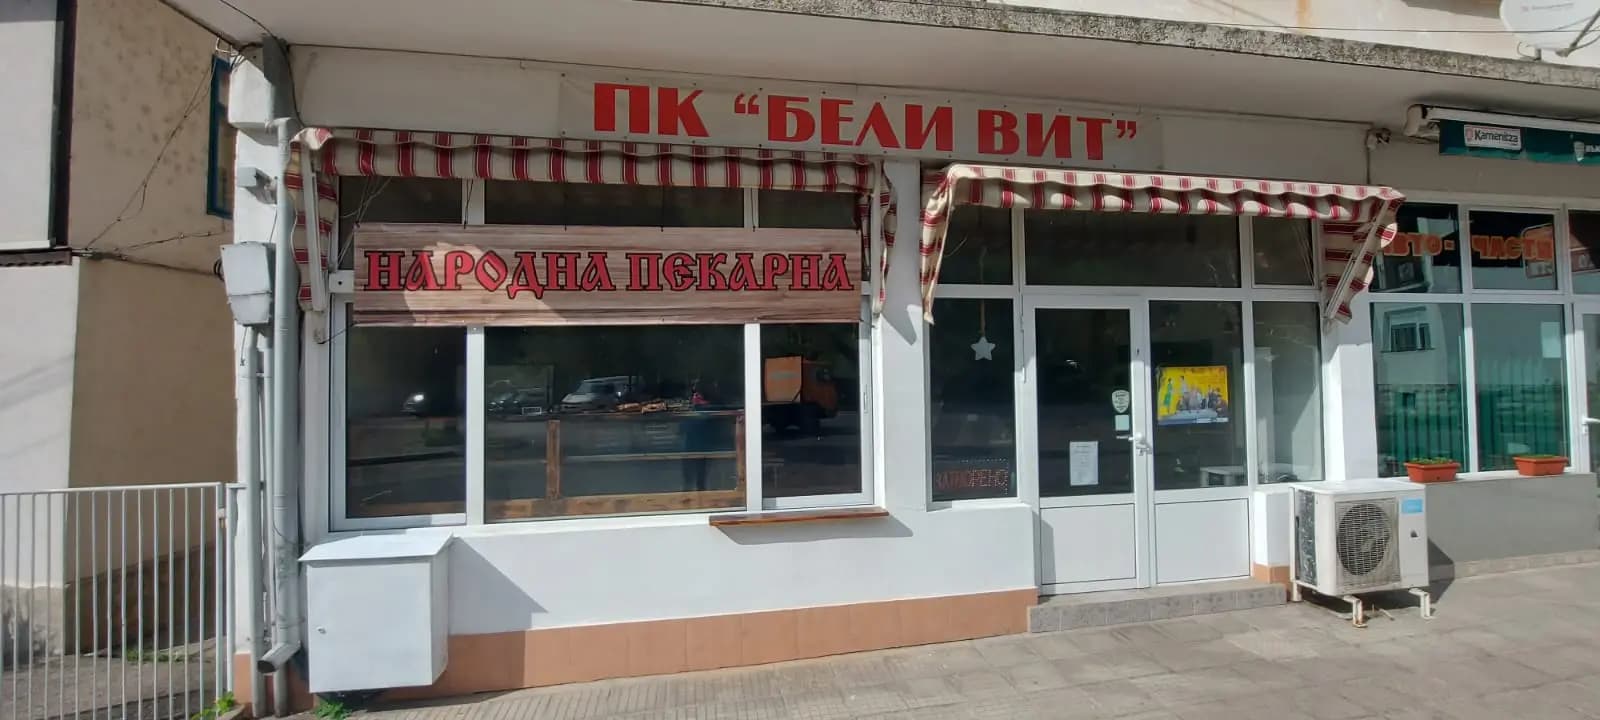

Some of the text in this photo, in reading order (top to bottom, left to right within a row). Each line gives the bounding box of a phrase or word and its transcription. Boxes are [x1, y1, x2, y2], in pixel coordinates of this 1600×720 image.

[594, 83, 709, 137] ПК
[1474, 129, 1519, 143] Kamenitza
[1384, 231, 1455, 256] ВТО-
[364, 250, 854, 299] НАРОДНА ПЕКАРНА
